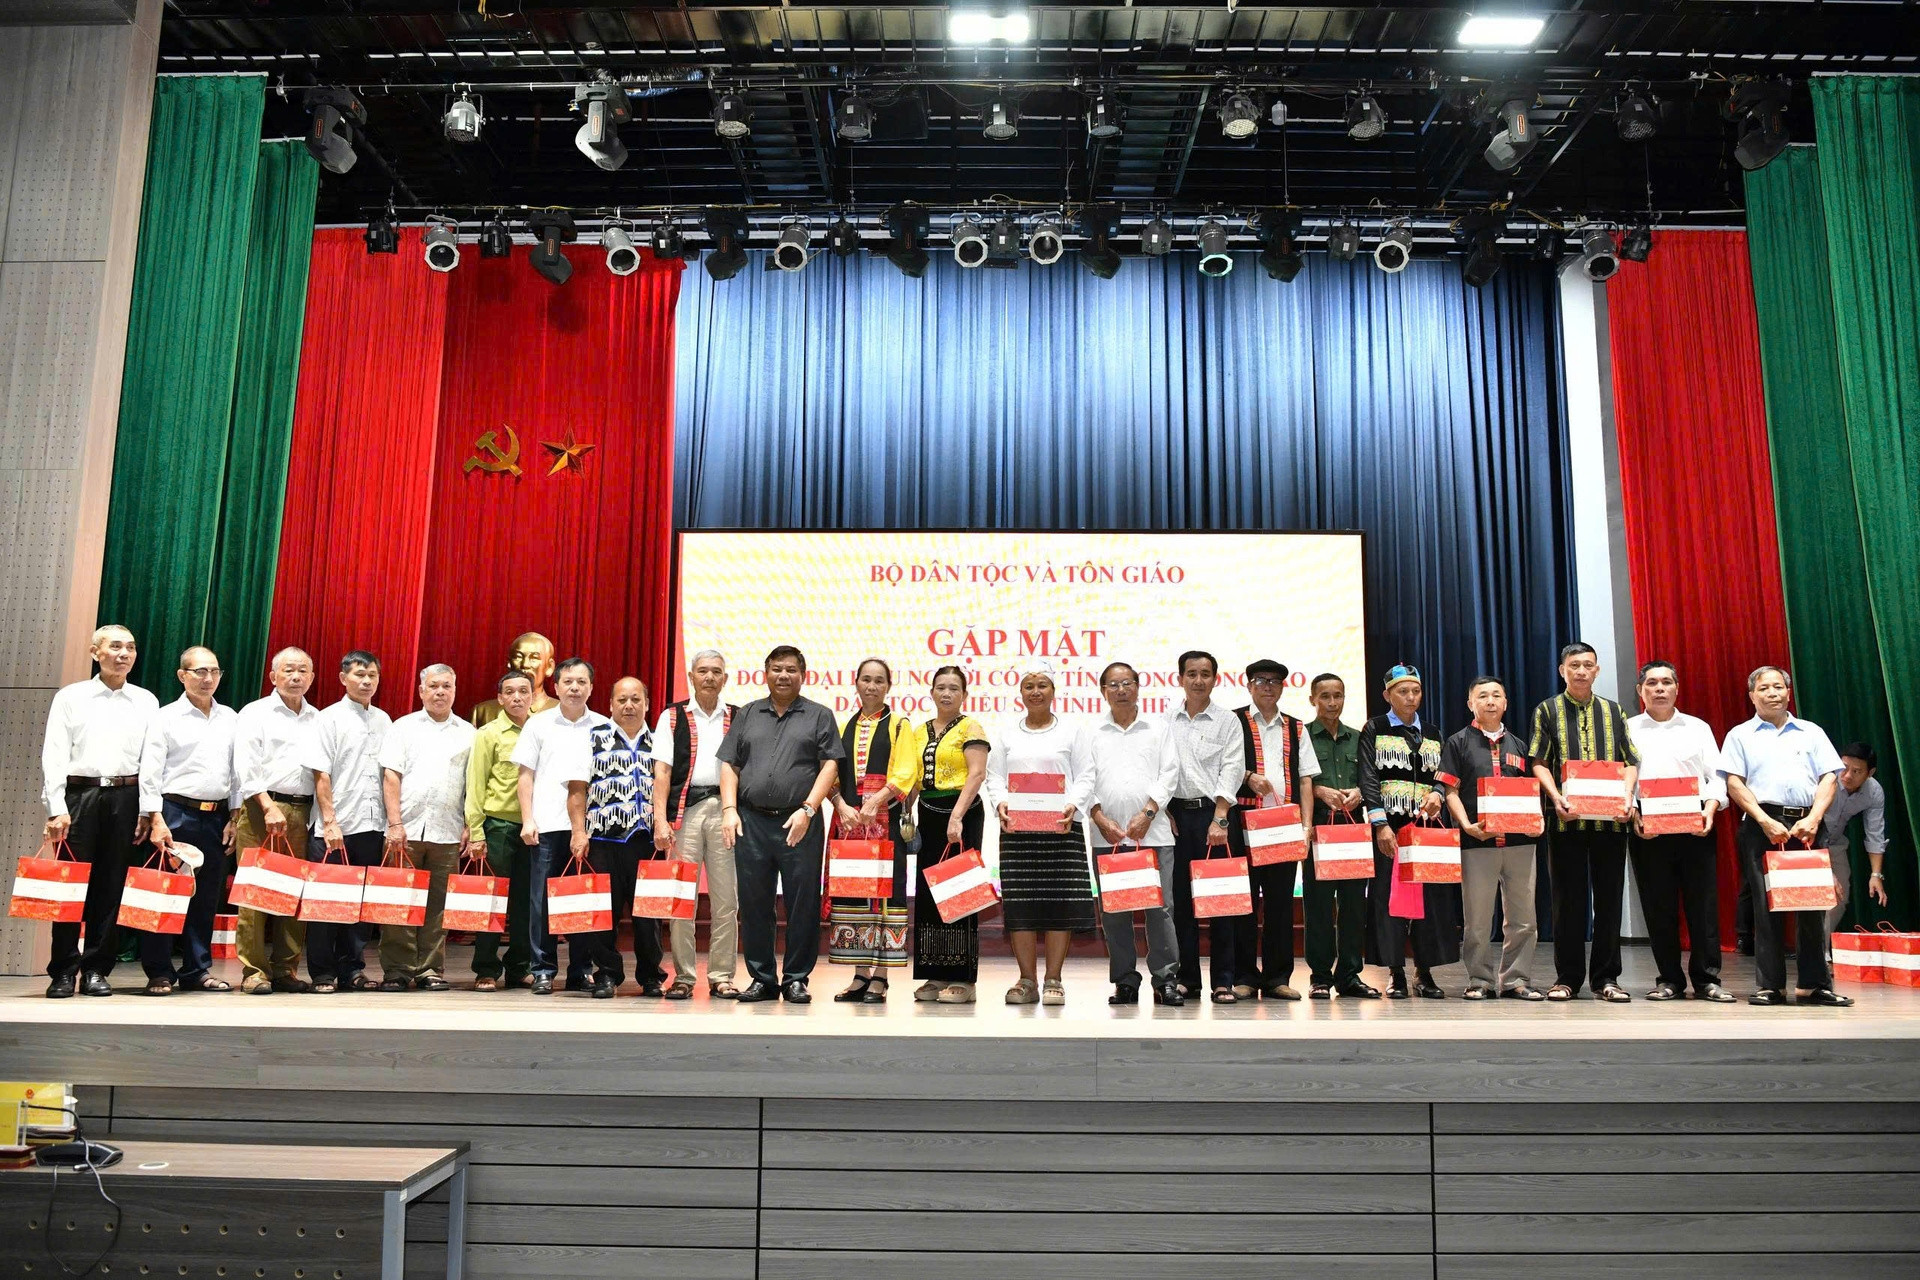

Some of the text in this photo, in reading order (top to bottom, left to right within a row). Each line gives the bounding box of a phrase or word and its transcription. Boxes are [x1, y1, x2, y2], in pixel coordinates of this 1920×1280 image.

[870, 560, 1185, 587] BỘ DÂN TỘC VÀ TÔN GIÁO
[927, 625, 1106, 665] GẶP MẶT
[805, 670, 845, 690] ĐẠI
[988, 665, 1020, 687] CÓ
[1061, 666, 1099, 687] TÍN
[886, 693, 932, 716] TỘC
[1051, 692, 1101, 714] TỈNH
